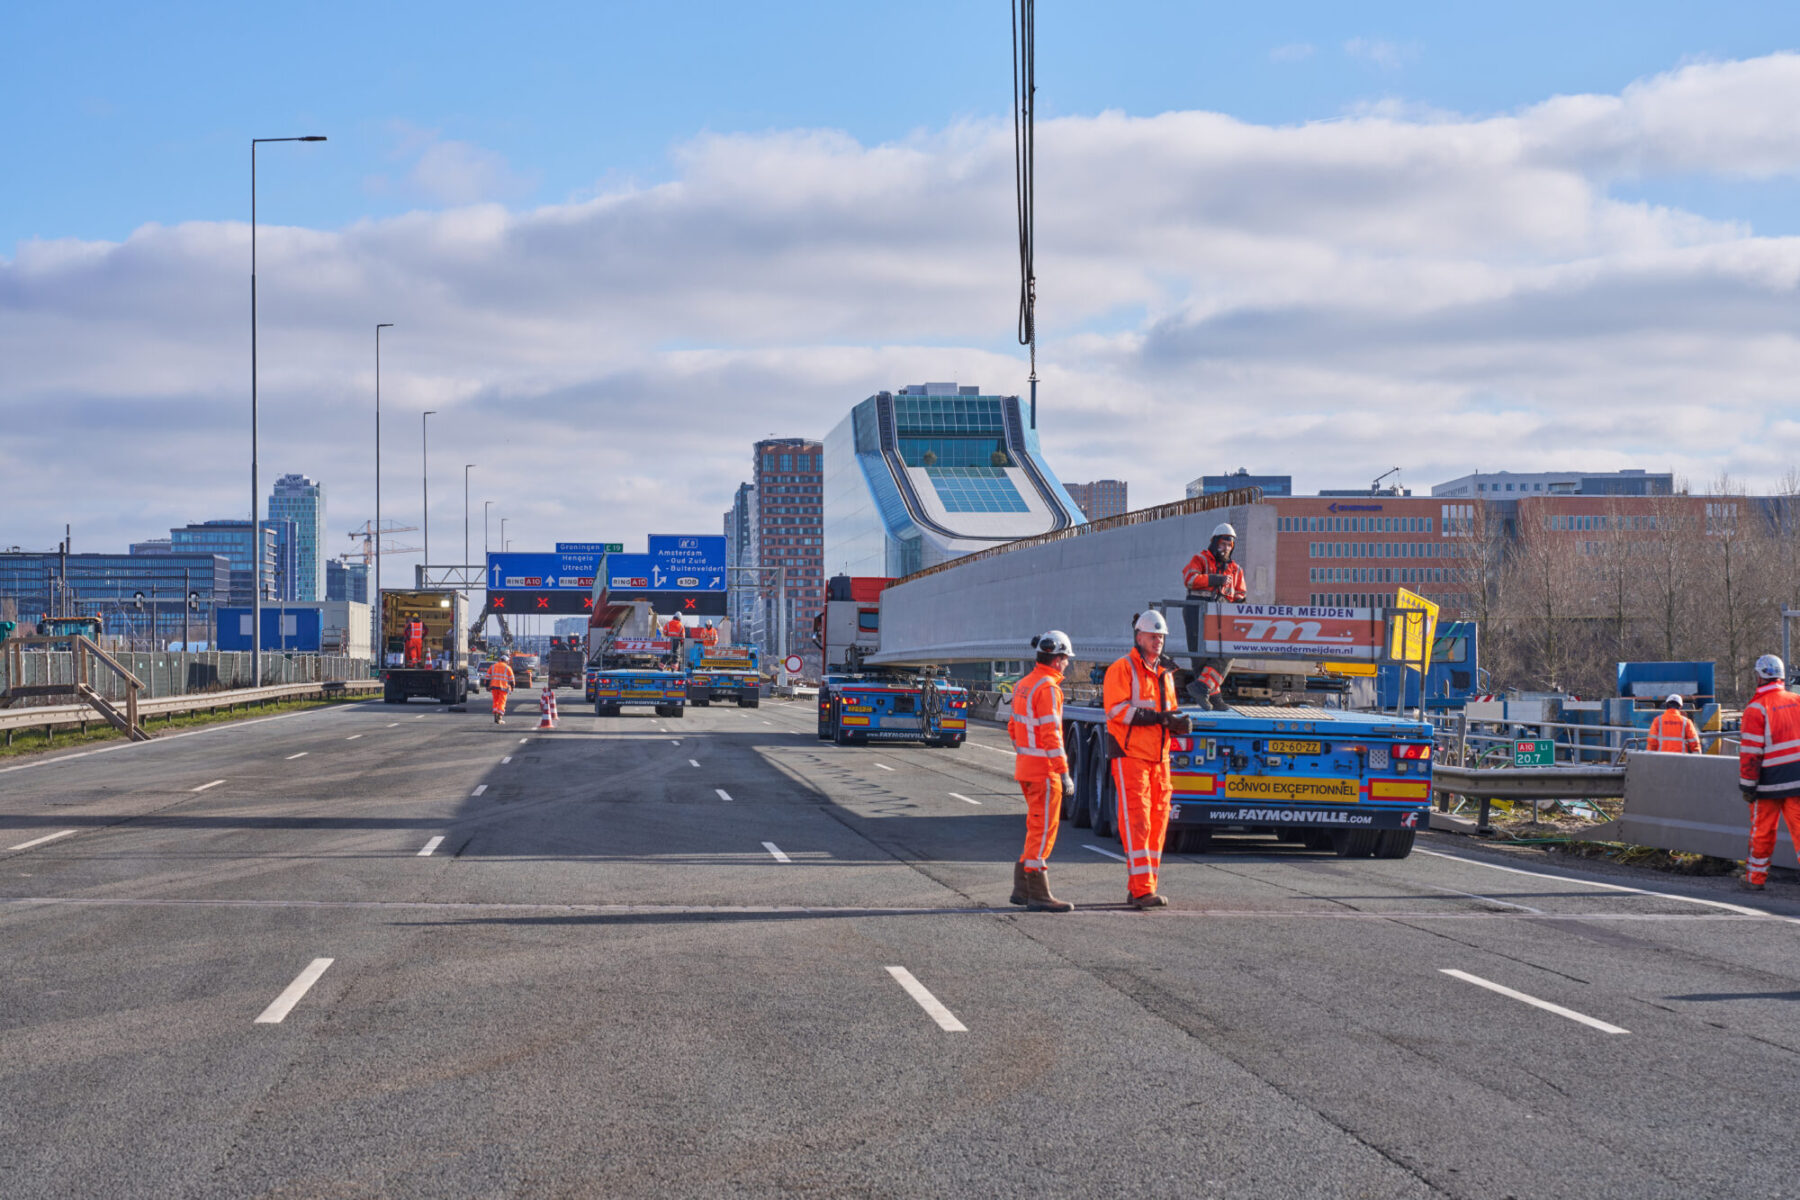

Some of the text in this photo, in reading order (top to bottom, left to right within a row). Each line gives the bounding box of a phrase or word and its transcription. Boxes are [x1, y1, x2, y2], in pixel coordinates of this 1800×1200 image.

[560, 543, 600, 552] Groningen
[1236, 605, 1355, 618] VAN DER MEIJDEN
[1233, 644, 1354, 656] www.wvandermeijden.nl
[1518, 754, 1541, 763] 20.7
[1227, 781, 1357, 797] CONVOI EXCEPTIONNEL
